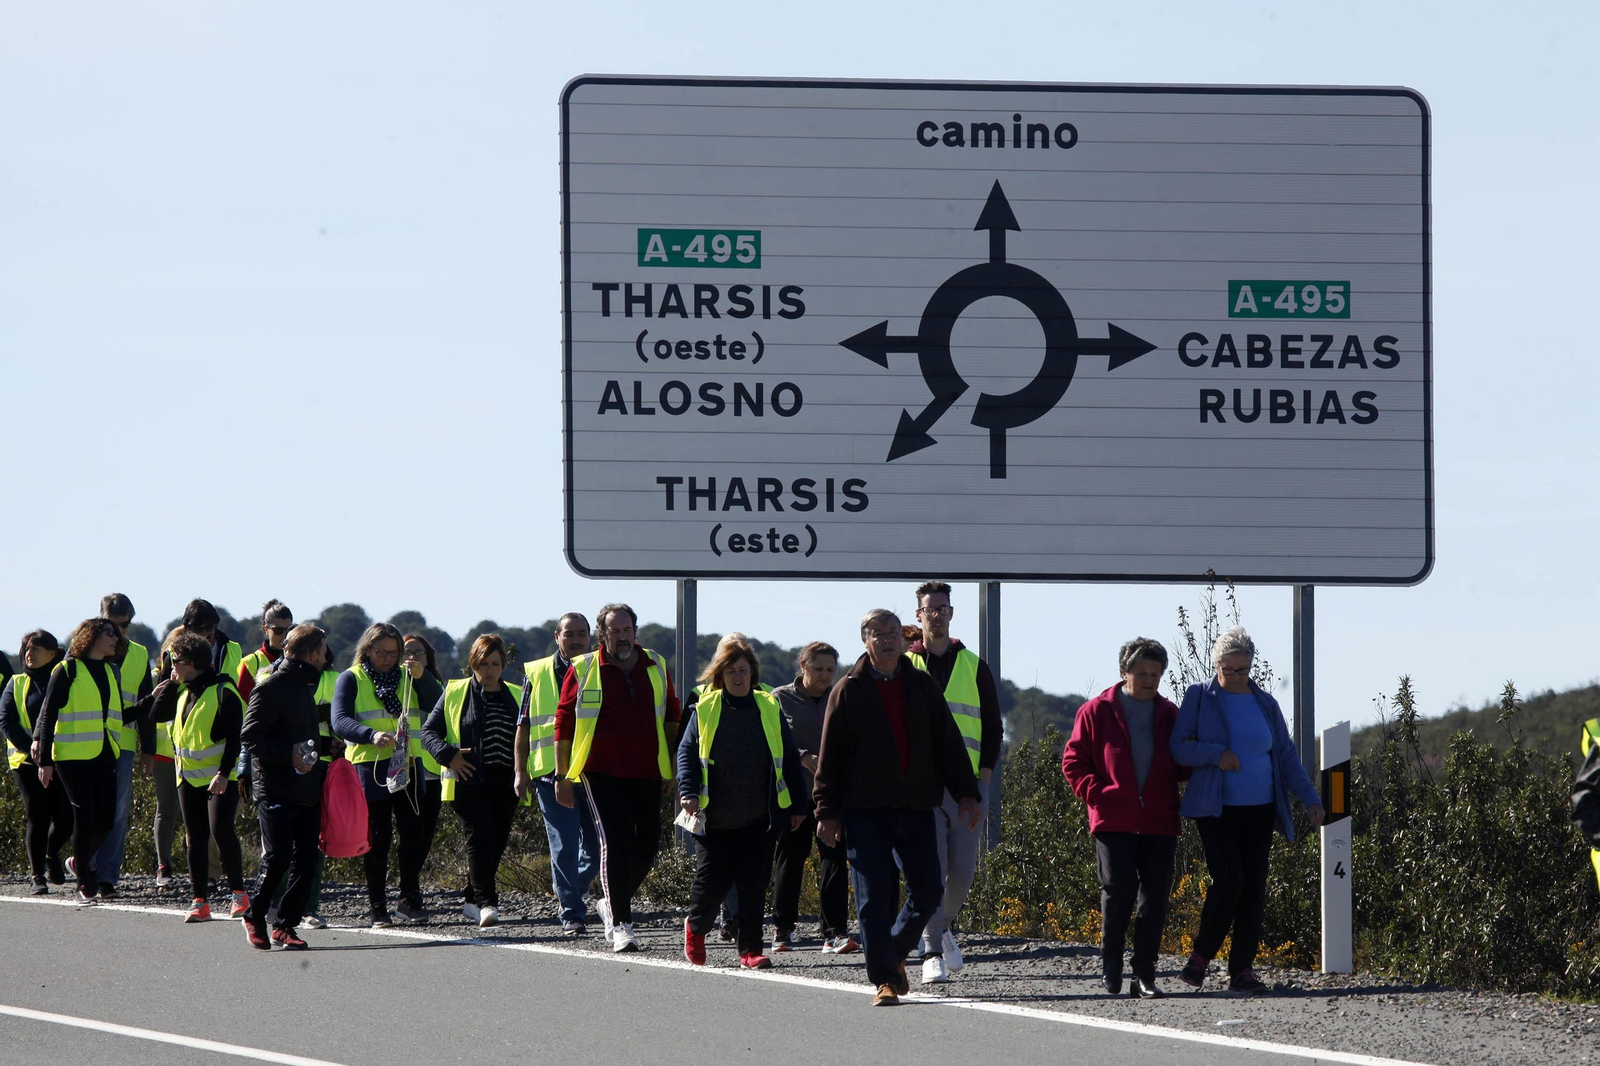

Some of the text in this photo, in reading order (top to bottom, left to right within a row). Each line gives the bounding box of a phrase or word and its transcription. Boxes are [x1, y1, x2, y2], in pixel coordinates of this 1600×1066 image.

[916, 113, 1079, 149] camino
[643, 234, 756, 262] A-495
[592, 282, 806, 319] THARSIS
[1233, 284, 1345, 314] A-495
[635, 328, 765, 364] (oeste)
[1177, 331, 1401, 370] CABEZAS
[597, 380, 804, 417] ALOSNO
[1199, 388, 1379, 425] RUBIAS
[656, 476, 870, 512] THARSIS
[709, 522, 818, 558] (este)
[1333, 860, 1346, 879] 4
